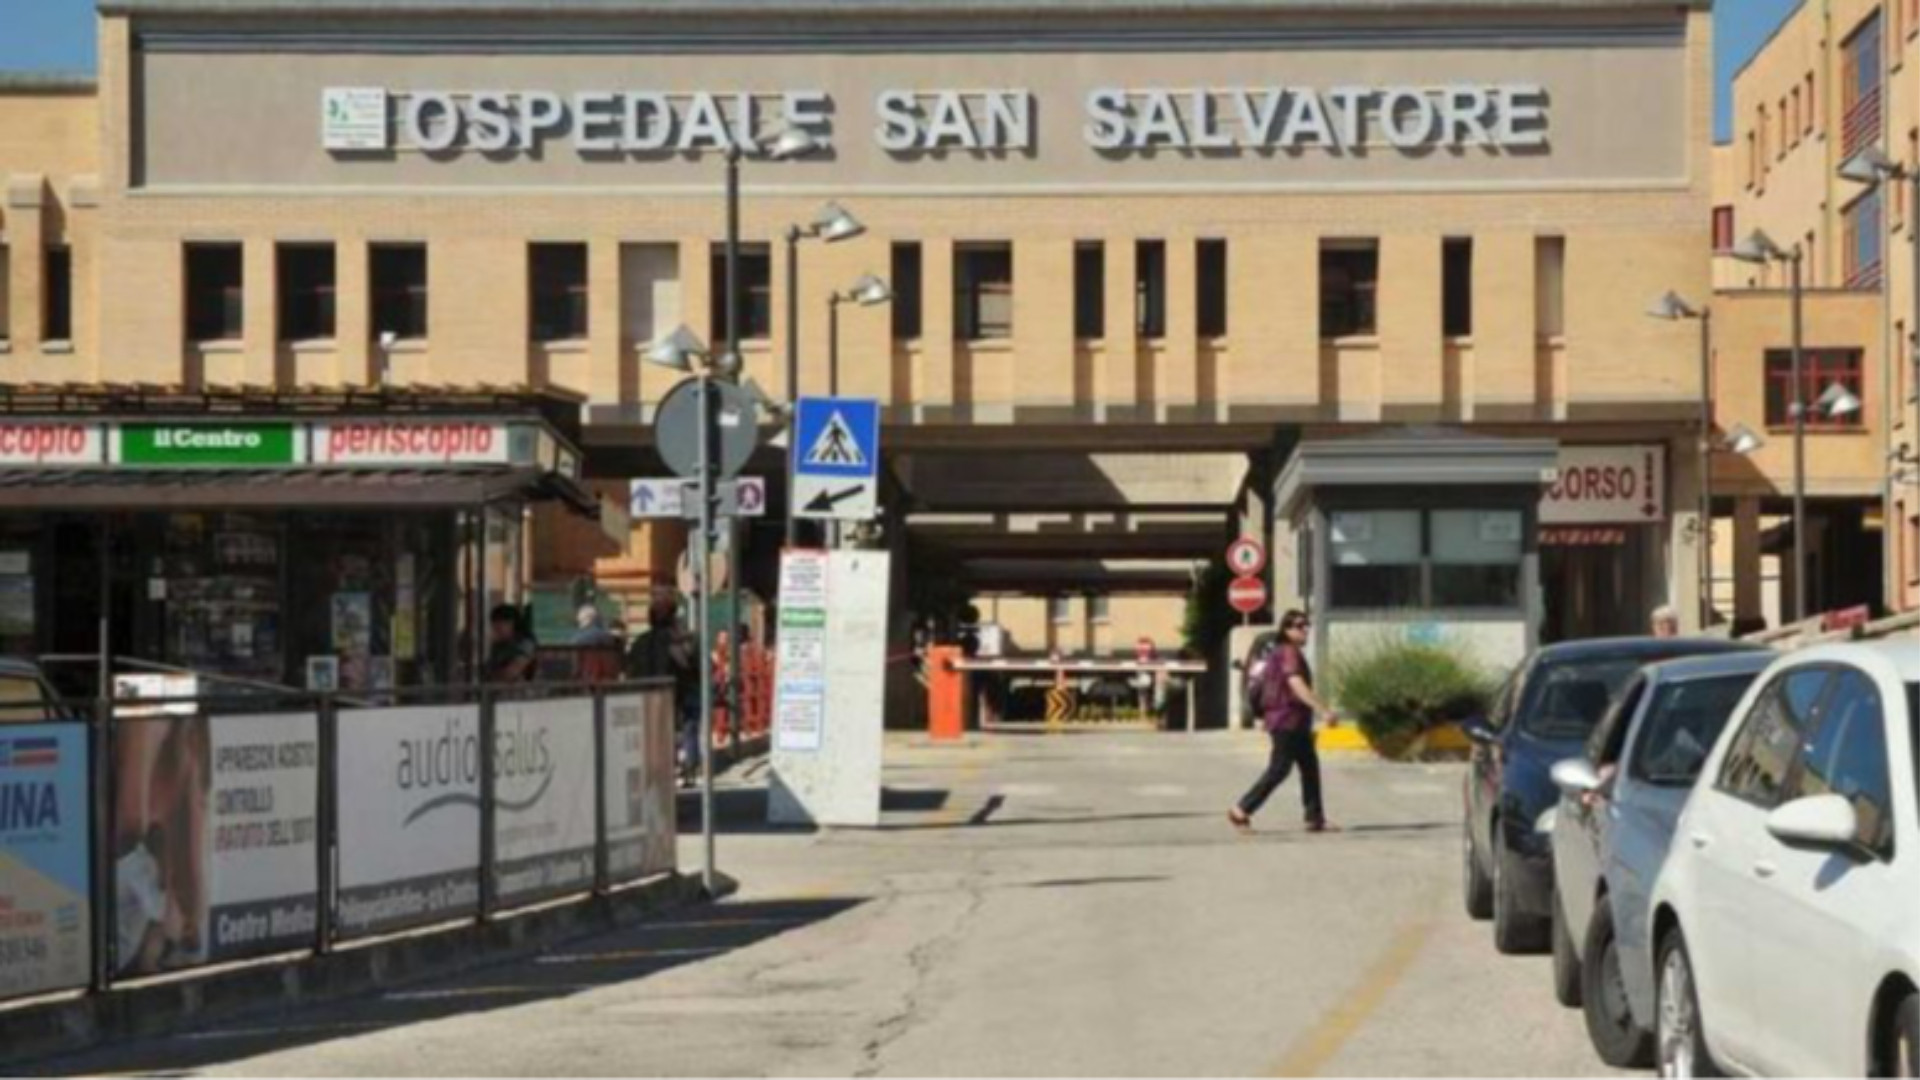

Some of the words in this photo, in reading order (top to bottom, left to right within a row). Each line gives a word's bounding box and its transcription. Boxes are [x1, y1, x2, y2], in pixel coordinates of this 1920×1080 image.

[407, 91, 832, 153] OSPEDALE
[875, 88, 1031, 150] SAN
[1083, 84, 1546, 149] SALVATORE
[328, 422, 492, 465] periscopio
[398, 717, 479, 790] audio
